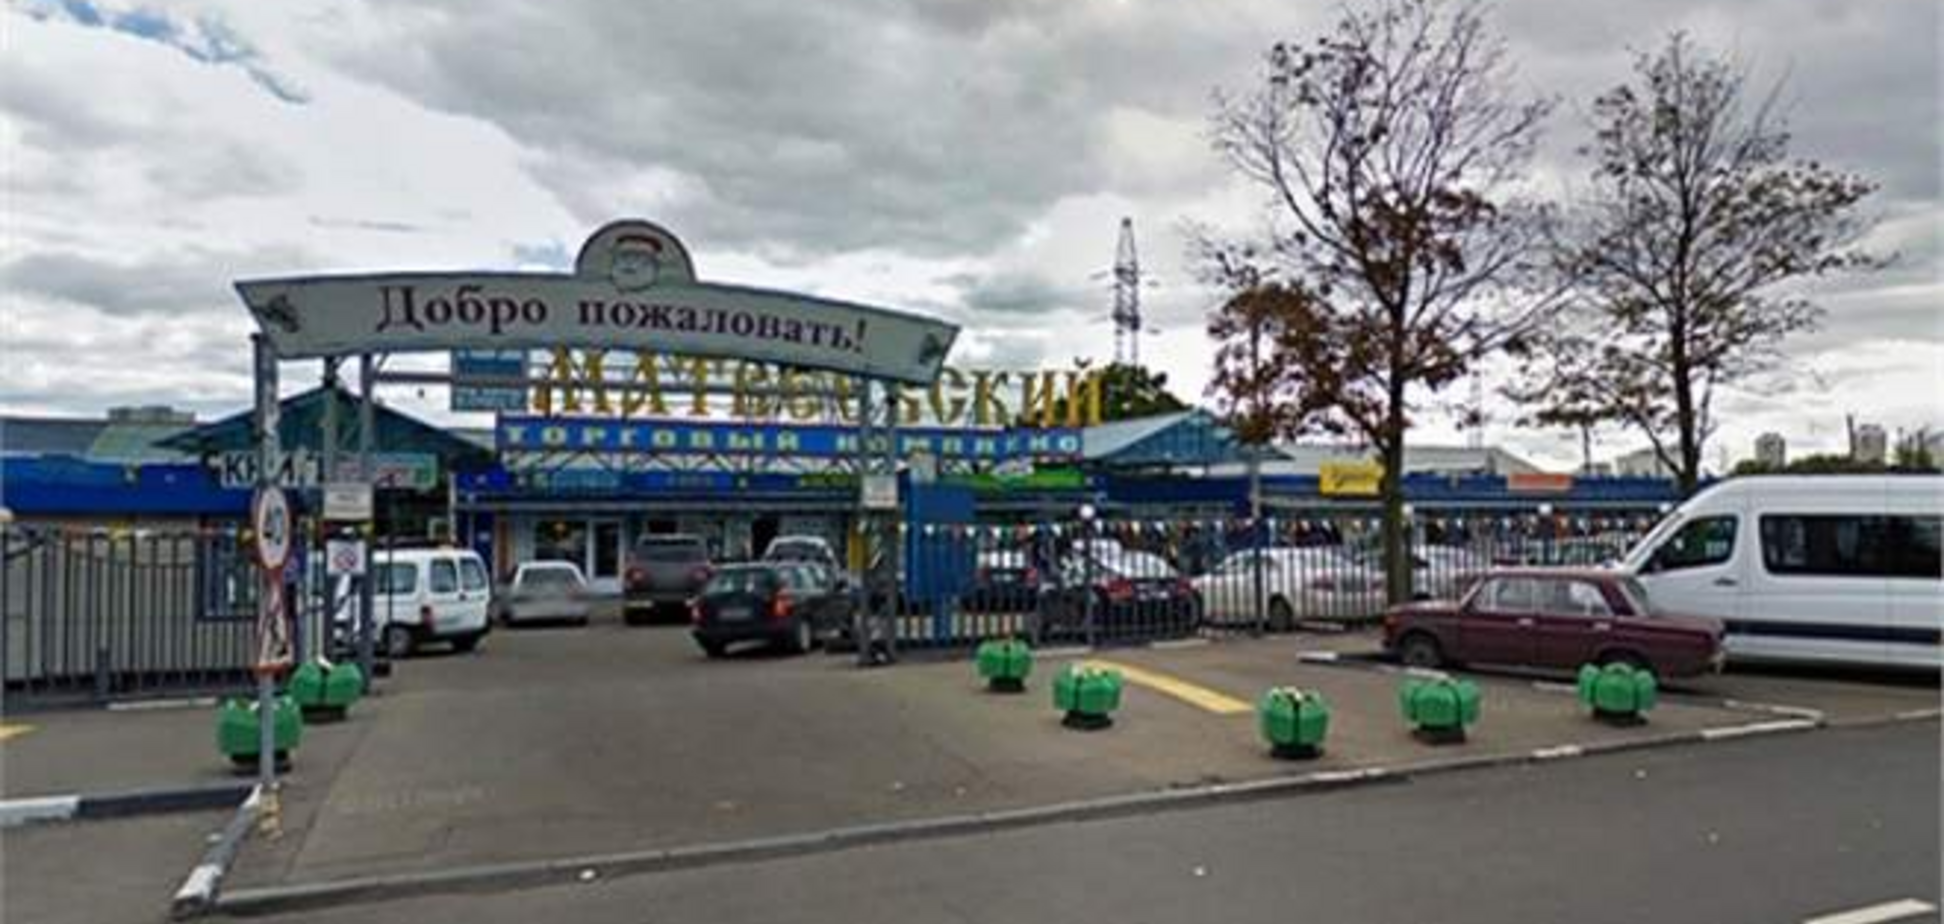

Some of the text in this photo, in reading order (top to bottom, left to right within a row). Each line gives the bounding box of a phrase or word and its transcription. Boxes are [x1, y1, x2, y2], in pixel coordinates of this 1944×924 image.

[376, 284, 867, 352] Добро пожаловать!
[505, 425, 799, 450] ТОРГОВЫЙ
